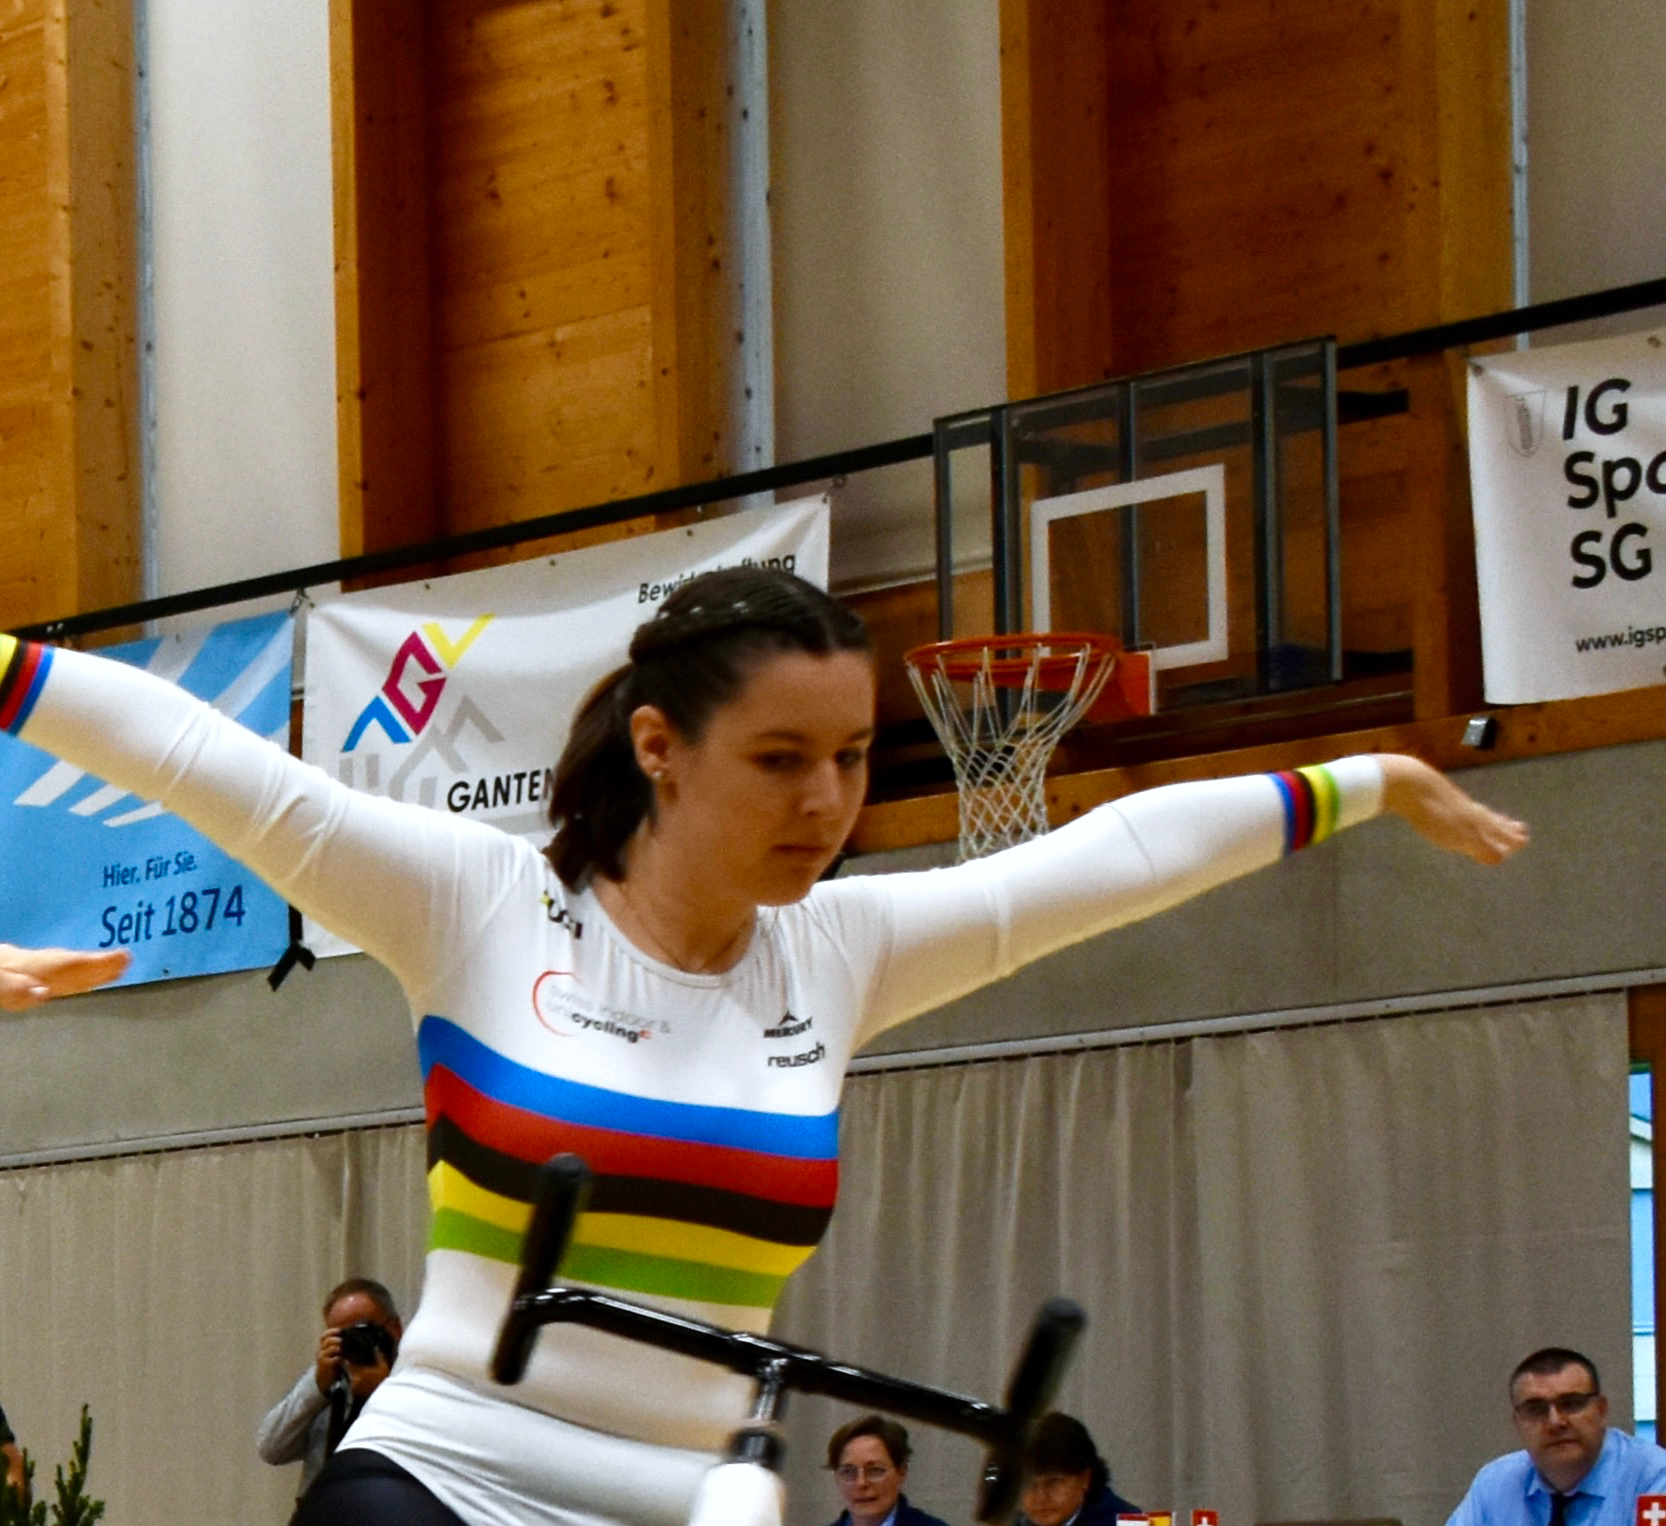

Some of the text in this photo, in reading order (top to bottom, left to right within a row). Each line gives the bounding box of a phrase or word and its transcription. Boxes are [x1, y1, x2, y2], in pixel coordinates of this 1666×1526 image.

[1562, 378, 1631, 441] IG
[1571, 522, 1652, 589] SG
[103, 864, 140, 888] Hier.
[145, 857, 170, 881] Für
[99, 885, 245, 948] Seit 1874
[768, 1042, 825, 1068] reusch
